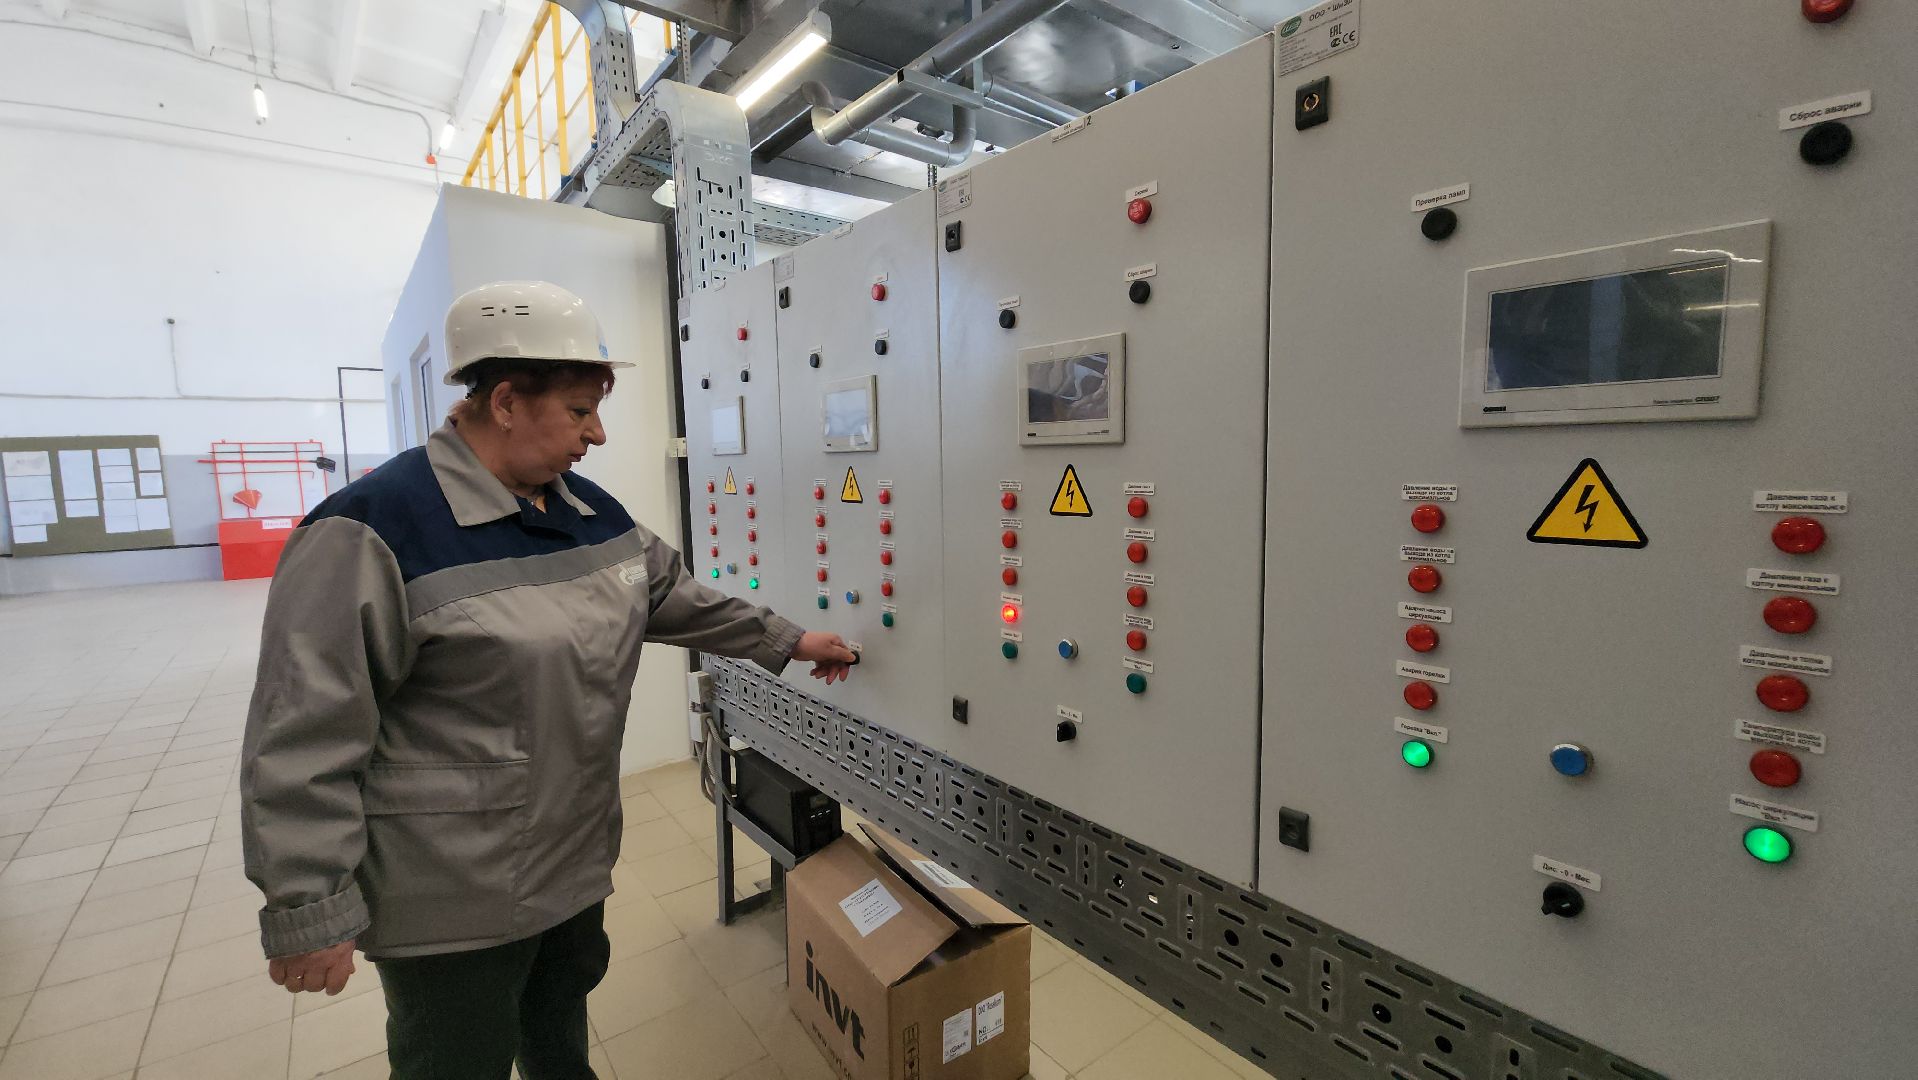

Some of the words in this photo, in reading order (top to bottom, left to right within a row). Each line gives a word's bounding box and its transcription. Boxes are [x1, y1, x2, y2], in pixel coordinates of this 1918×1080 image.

[1789, 109, 1822, 121] Сброс
[1824, 102, 1862, 114] аварии
[1086, 115, 1092, 126] 2
[1415, 194, 1447, 206] Проверка
[1448, 189, 1466, 199] ламп
[1766, 493, 1808, 501] Давление
[1401, 667, 1422, 675] Авария
[805, 940, 866, 1062] invt
